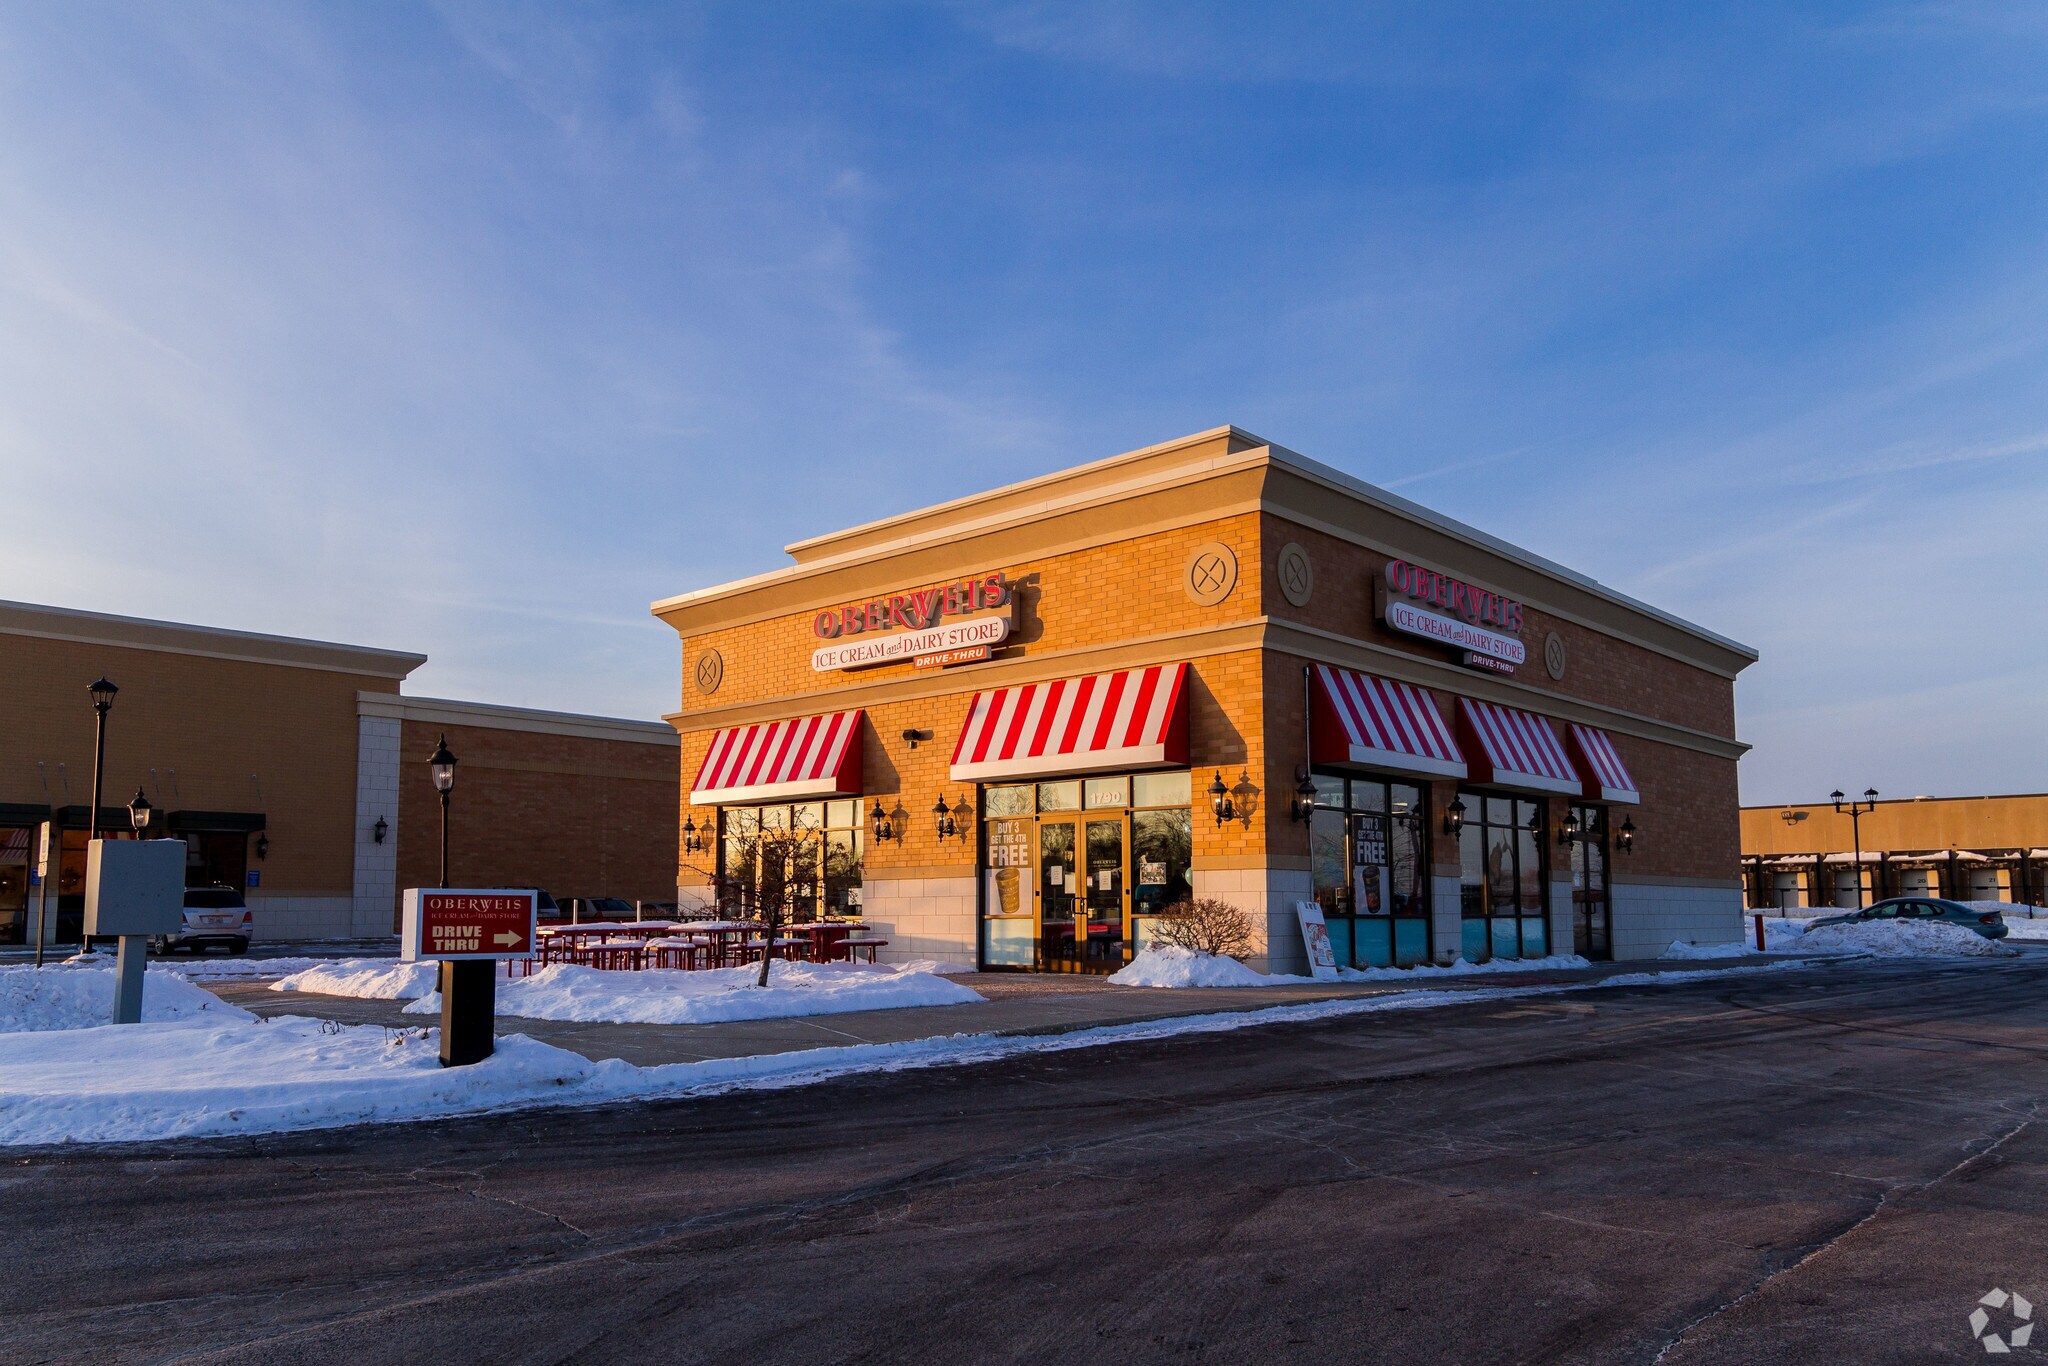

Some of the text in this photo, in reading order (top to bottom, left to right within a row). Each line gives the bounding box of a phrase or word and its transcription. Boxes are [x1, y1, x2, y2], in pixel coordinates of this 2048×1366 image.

[1392, 559, 1523, 632] OBERWEIS
[813, 573, 1004, 639] OBERWEIS
[1395, 608, 1523, 661] ICE CREAM and DAIRY STORE
[815, 622, 999, 668] ICE CREAM and DAIRY STORE
[916, 648, 984, 667] DRIVE-THRU
[1472, 654, 1515, 673] DRIVE-THRU
[1090, 792, 1121, 804] 1790
[997, 822, 1020, 834] BUY 3
[991, 833, 1026, 844] GET THE 4TH
[989, 845, 1028, 866] FREE
[1357, 841, 1386, 864] FREE
[430, 899, 521, 912] OBERWEIS
[432, 925, 482, 938] DRIVE
[434, 939, 479, 951] THRU
